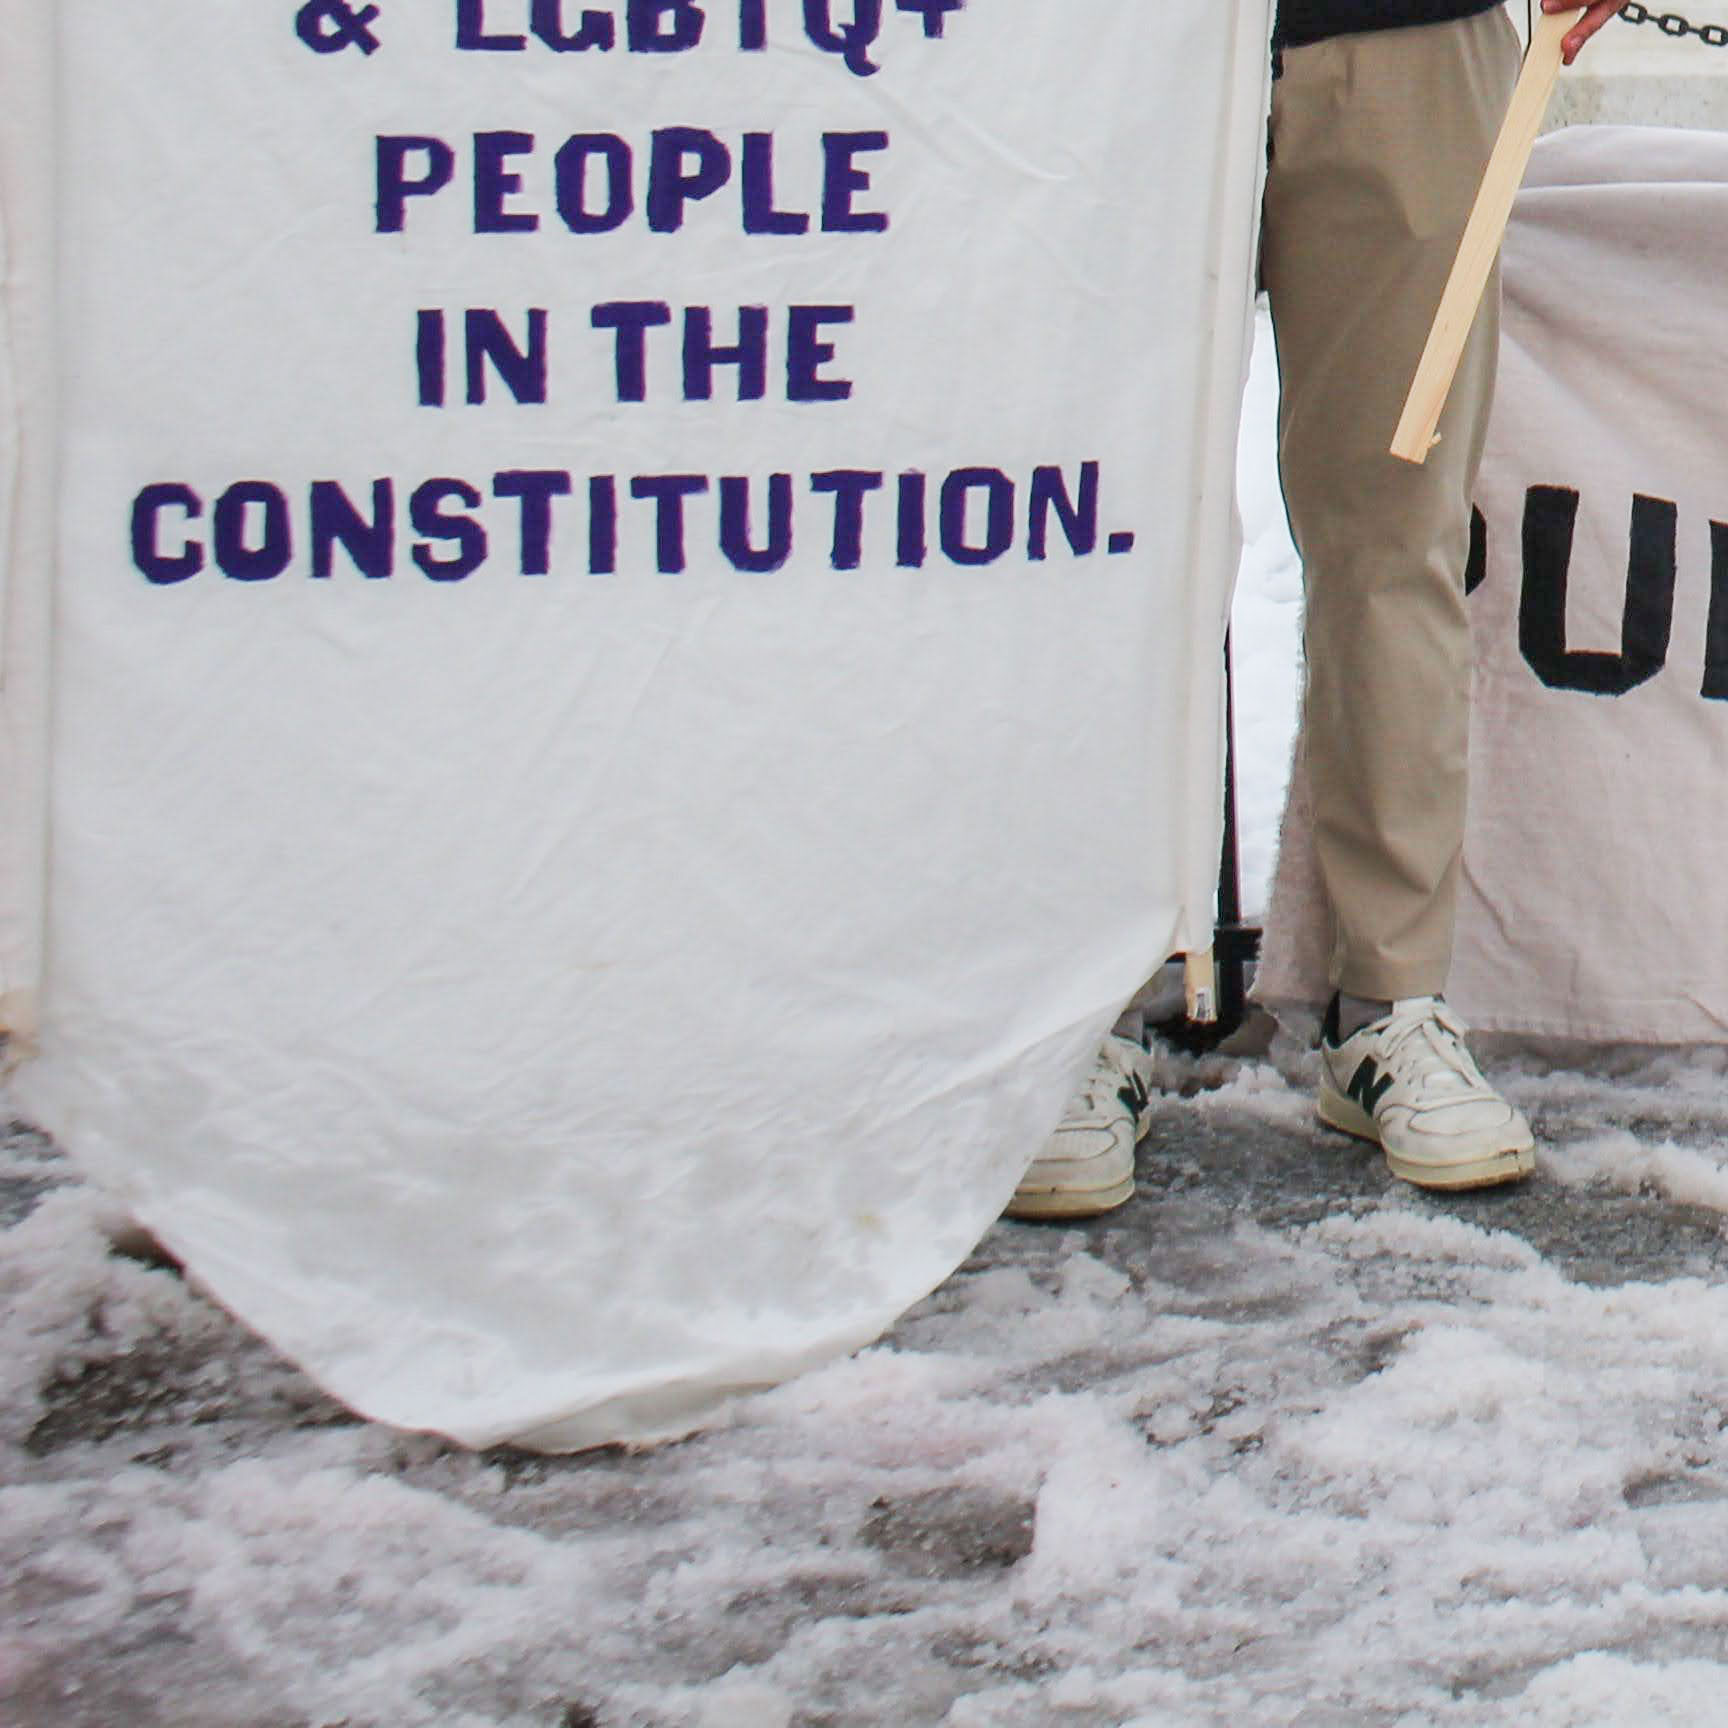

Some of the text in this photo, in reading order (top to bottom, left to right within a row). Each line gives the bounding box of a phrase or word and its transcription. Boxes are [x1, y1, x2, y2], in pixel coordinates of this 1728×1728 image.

[373, 128, 891, 236] PEOPLE
[413, 300, 857, 408] IN THE
[128, 460, 1136, 586] CONSTITUTION.
